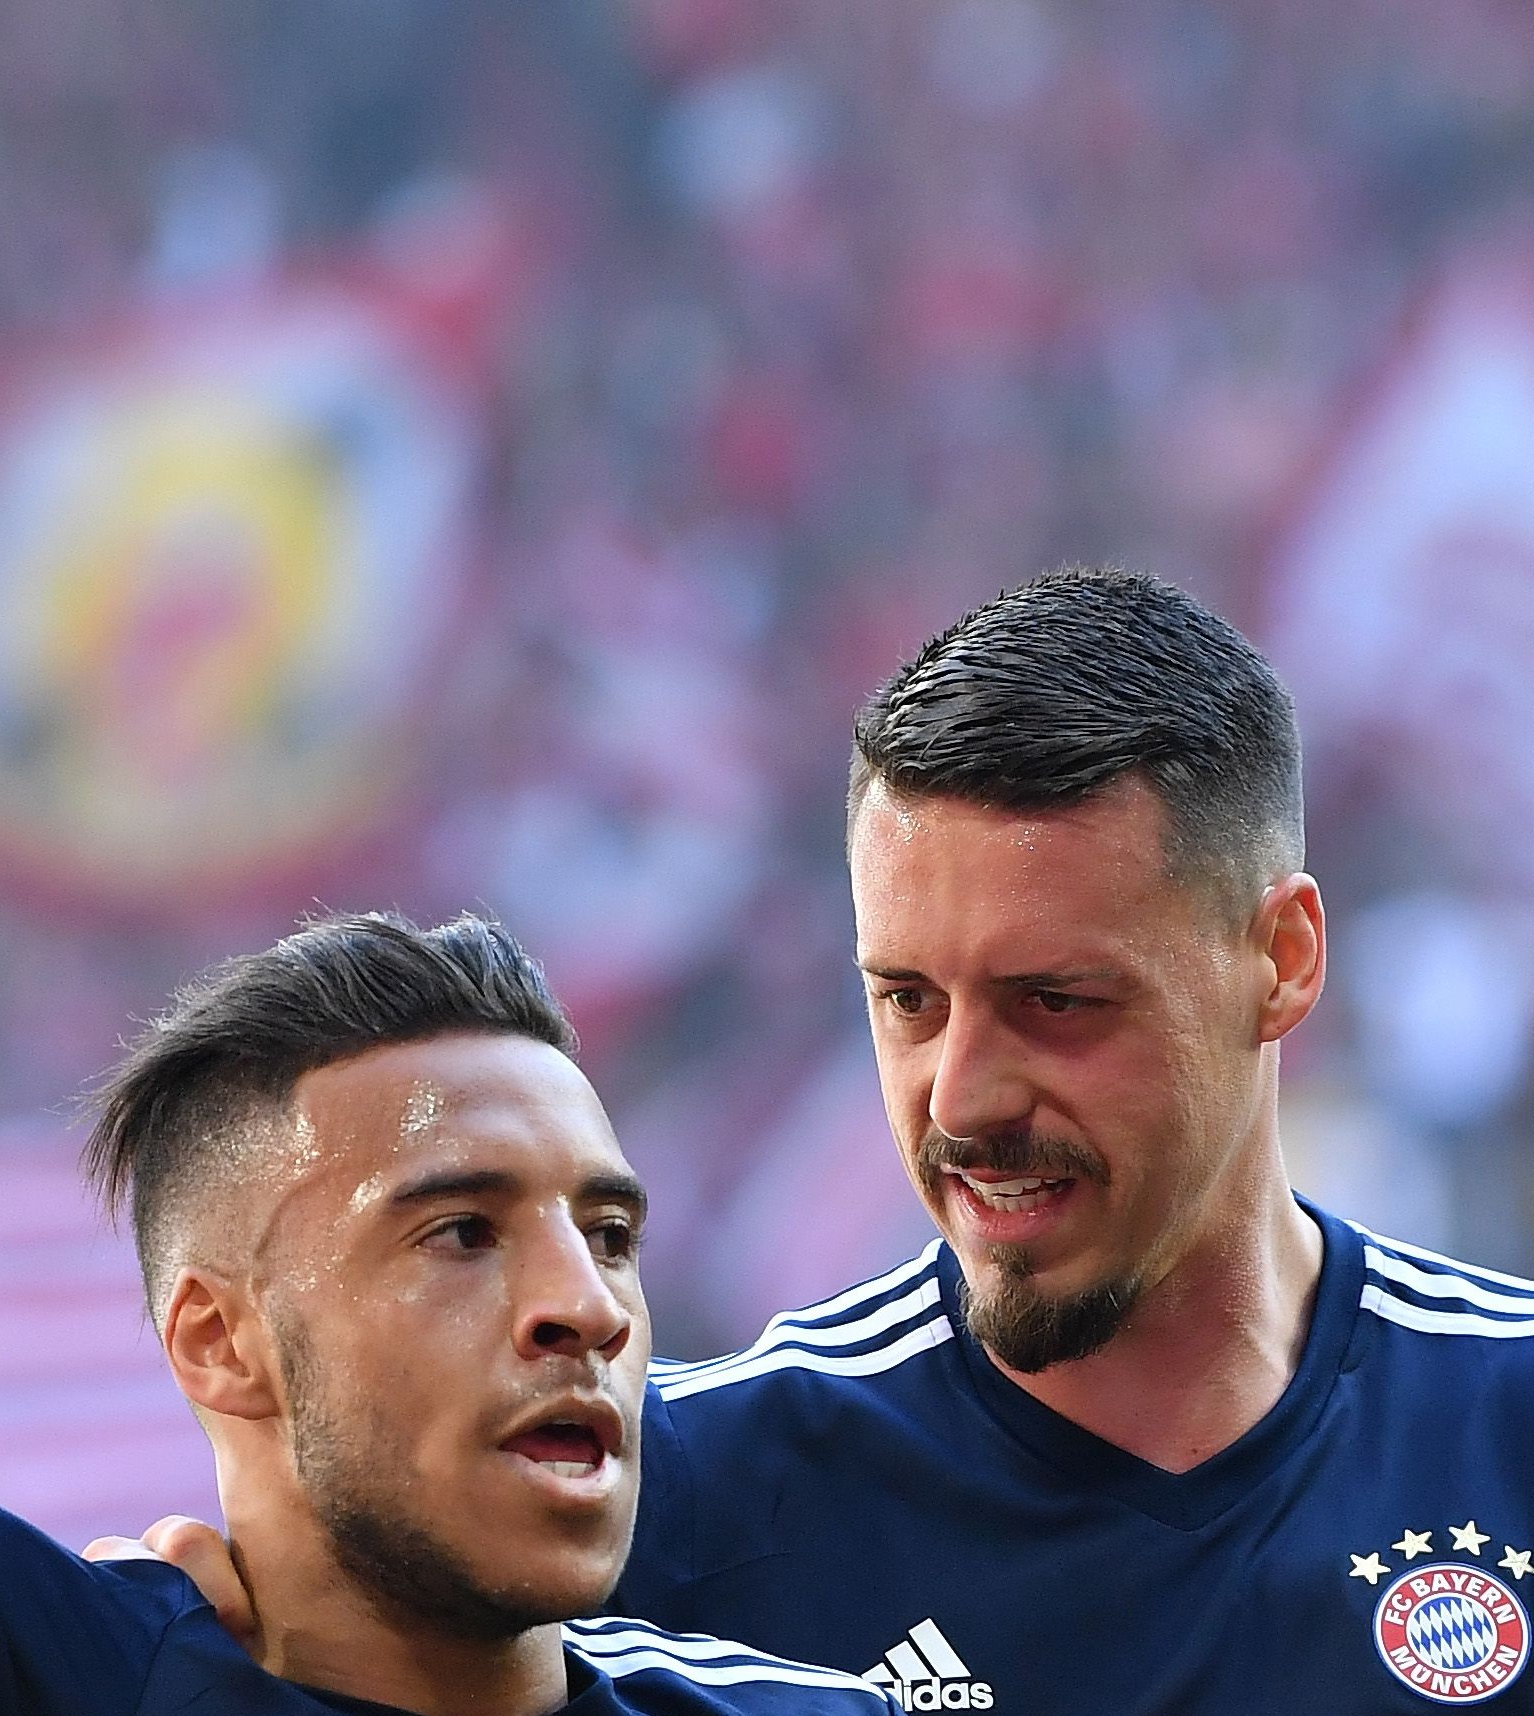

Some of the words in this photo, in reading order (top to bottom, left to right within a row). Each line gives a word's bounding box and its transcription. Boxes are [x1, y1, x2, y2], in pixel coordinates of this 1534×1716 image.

[1384, 1593, 1413, 1626] FC
[1409, 1572, 1517, 1625] BAYERN
[882, 1676, 995, 1713] didas
[1389, 1644, 1519, 1695] MÜNCHEN
